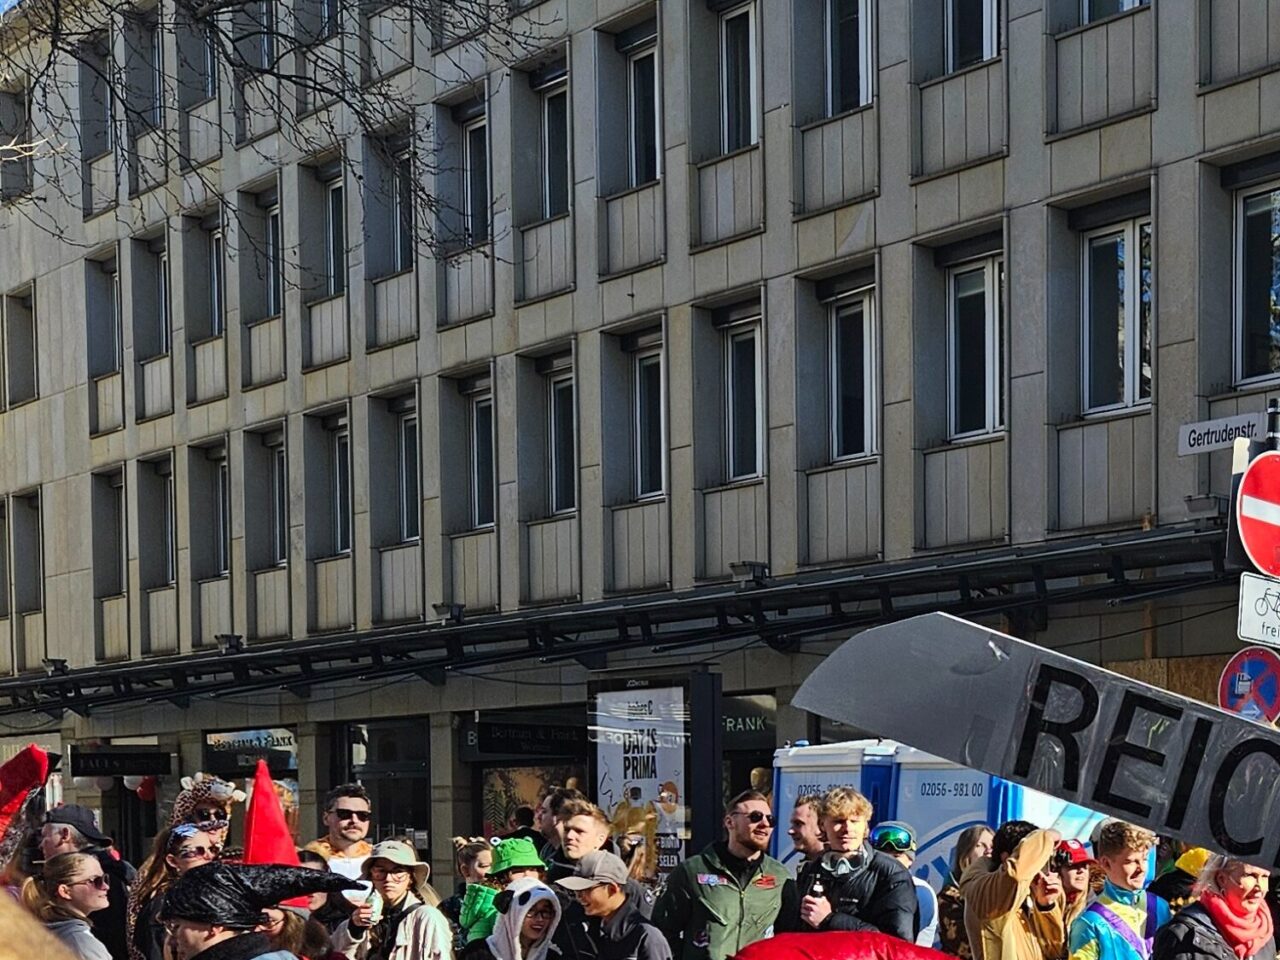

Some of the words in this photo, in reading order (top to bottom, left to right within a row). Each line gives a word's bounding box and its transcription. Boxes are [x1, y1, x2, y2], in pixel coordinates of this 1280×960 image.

[1188, 421, 1258, 448] Gertrudenstr.
[1261, 621, 1280, 638] frei
[623, 755, 657, 779] PRIMA
[921, 782, 946, 796] 02056
[954, 783, 969, 797] 981
[971, 783, 983, 797] 00
[659, 855, 678, 867] SELEN
